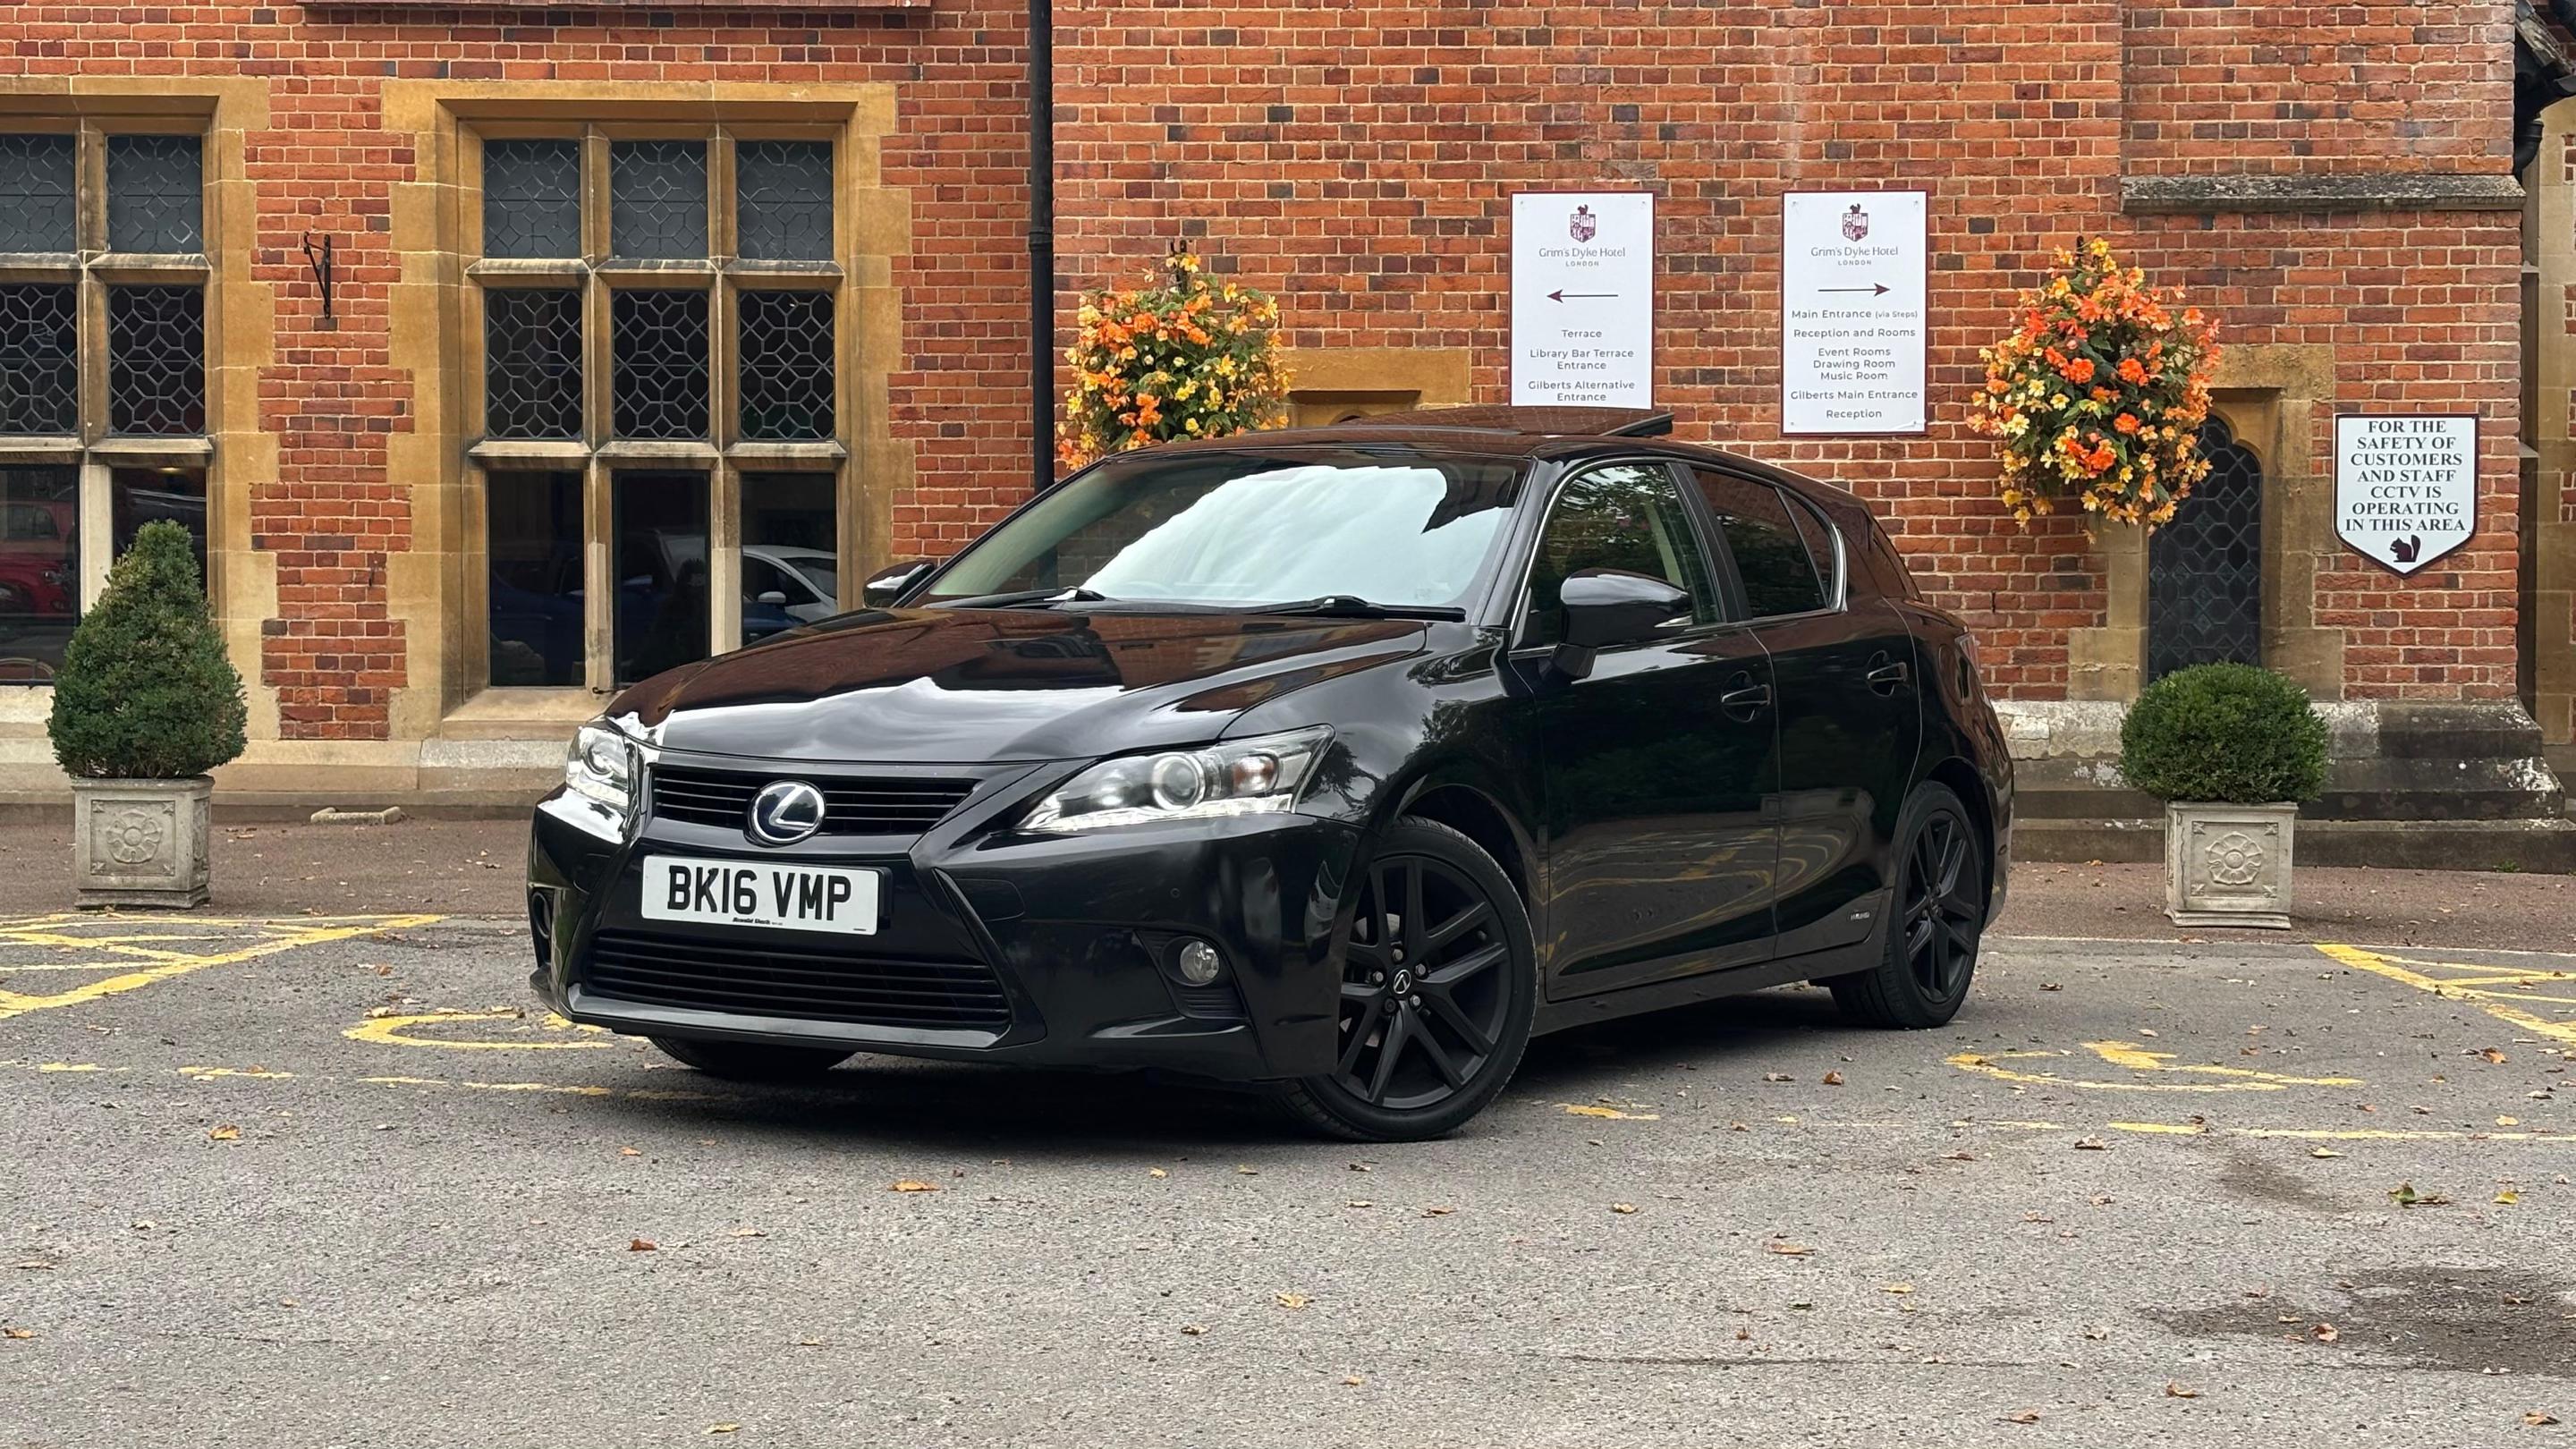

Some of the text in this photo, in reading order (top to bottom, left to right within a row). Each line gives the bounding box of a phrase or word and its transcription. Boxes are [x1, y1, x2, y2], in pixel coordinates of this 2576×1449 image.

[1572, 248, 1597, 258] Dyke
[1599, 247, 1625, 257] Hotel
[1844, 247, 1870, 258] Dyke
[1872, 246, 1898, 256] Hotel
[1792, 310, 1818, 318] Main
[1822, 310, 1871, 318] Entrance
[1562, 329, 1602, 338] Terrace
[1793, 328, 1916, 339] Reception and Rooms
[1530, 349, 1633, 360] Library Bar Terrace
[1818, 348, 1891, 356] Event Rooms
[1557, 361, 1606, 369] Entrance
[1813, 360, 1895, 369] Drawing Room
[1820, 372, 1888, 380] Music Room
[1529, 381, 1634, 389] Gilberts Alternative
[1791, 390, 1918, 400] Gilberts Main Entrance
[1826, 410, 1882, 419] Reception
[2368, 421, 2446, 433] FOR THE
[2357, 437, 2456, 449] SAFETY OF
[2351, 453, 2462, 465] CUSTOMERS
[2357, 470, 2456, 482] AND STAFF
[2371, 486, 2441, 498] CCTV IS
[2352, 503, 2459, 514] OPERATING
[2345, 519, 2465, 530] IN THIS AREA
[667, 865, 851, 921] BK16 VMP
